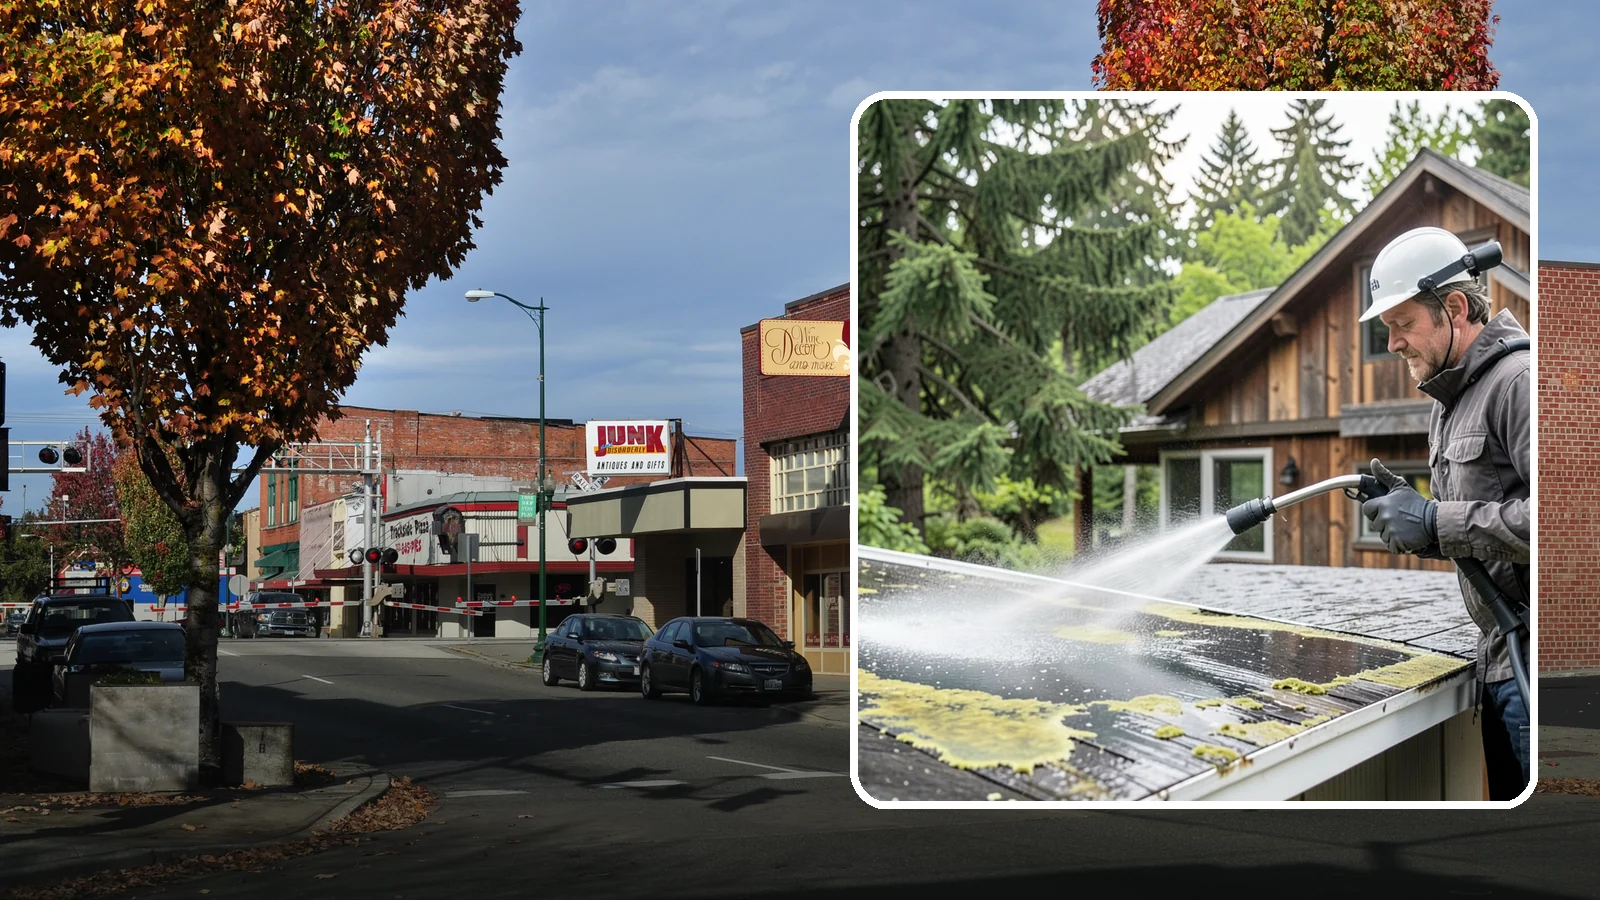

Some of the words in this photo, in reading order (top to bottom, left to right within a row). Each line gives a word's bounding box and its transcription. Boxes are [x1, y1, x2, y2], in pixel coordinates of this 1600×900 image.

[595, 425, 665, 457] JUNK
[607, 446, 646, 454] DISORDERLY
[597, 461, 628, 470] ANTIQUES
[631, 461, 643, 470] AND
[647, 460, 665, 470] GIFTS
[390, 521, 413, 540] Trackside
[414, 519, 429, 535] Pizza
